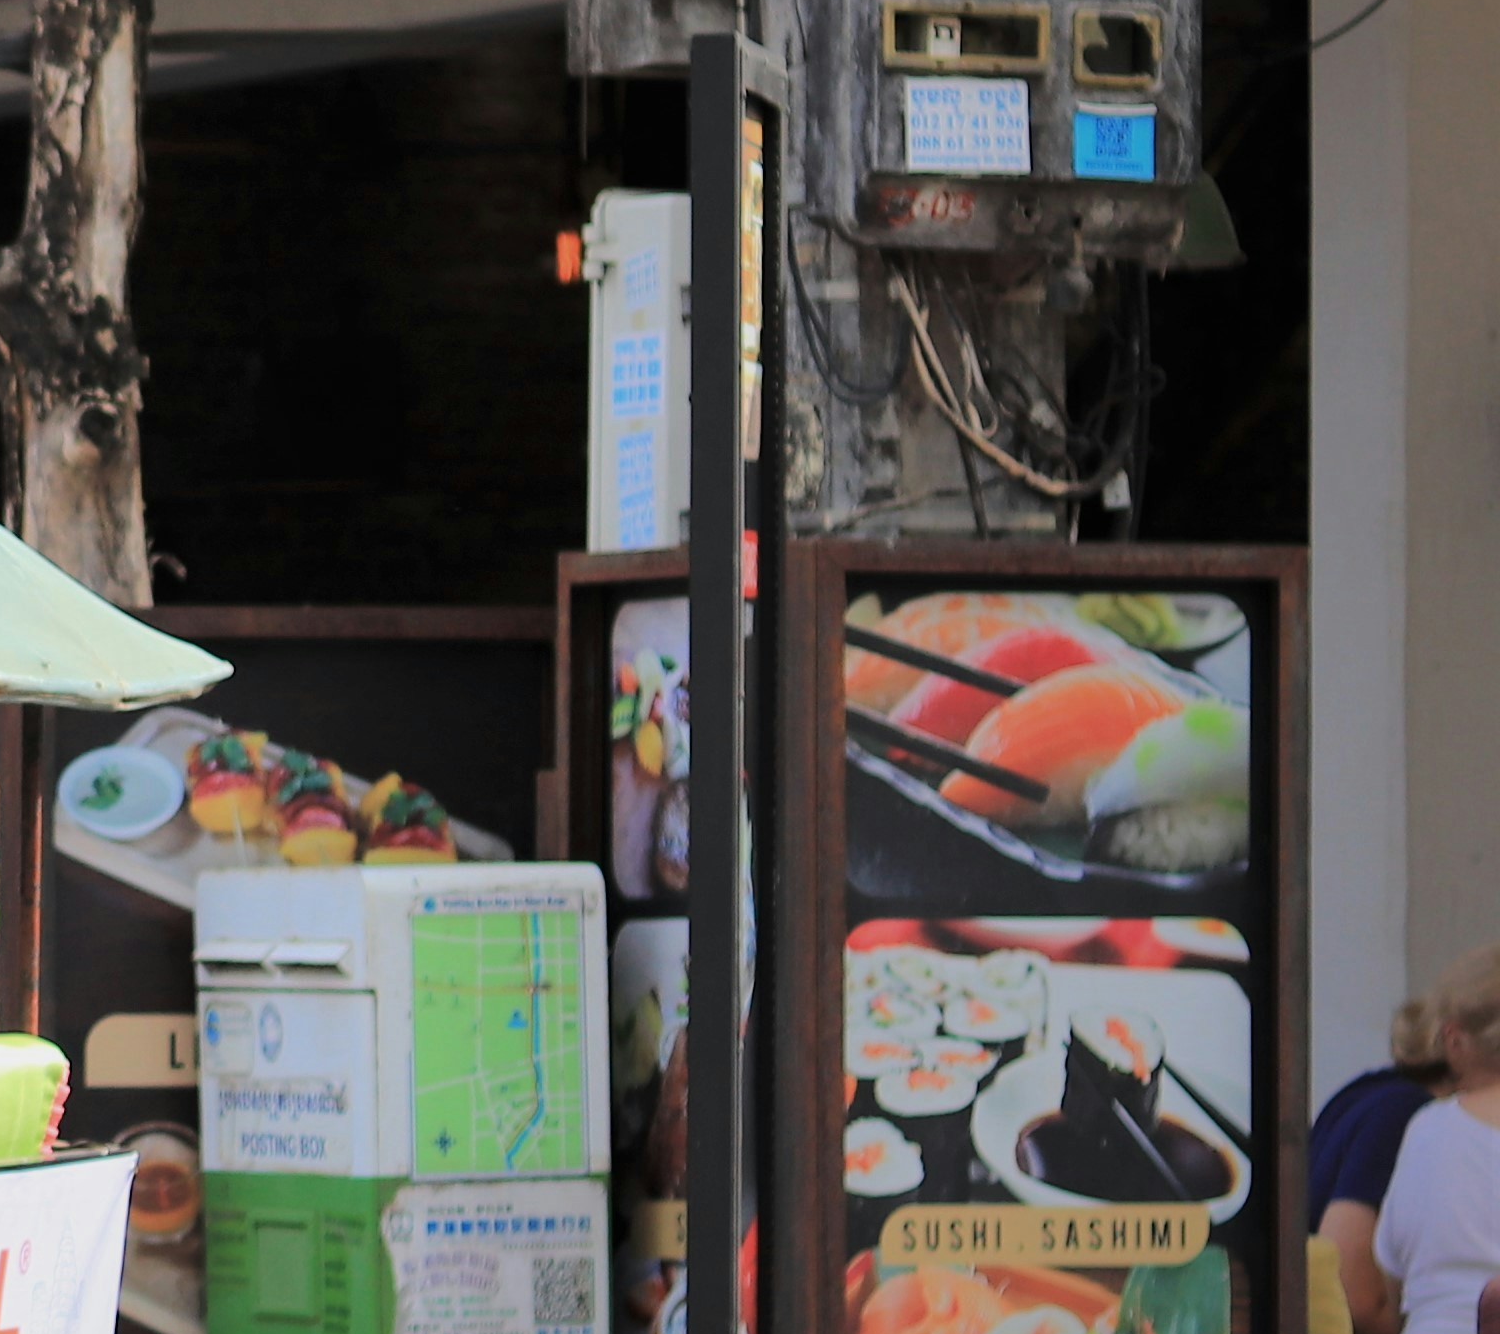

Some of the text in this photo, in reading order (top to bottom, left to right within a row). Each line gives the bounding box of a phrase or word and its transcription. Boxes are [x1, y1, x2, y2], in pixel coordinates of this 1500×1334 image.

[911, 114, 940, 129] 012
[241, 1132, 328, 1160] POSTING BOX
[902, 1218, 1003, 1252] SUSHI
[1042, 1217, 1188, 1252] SASHIMI
